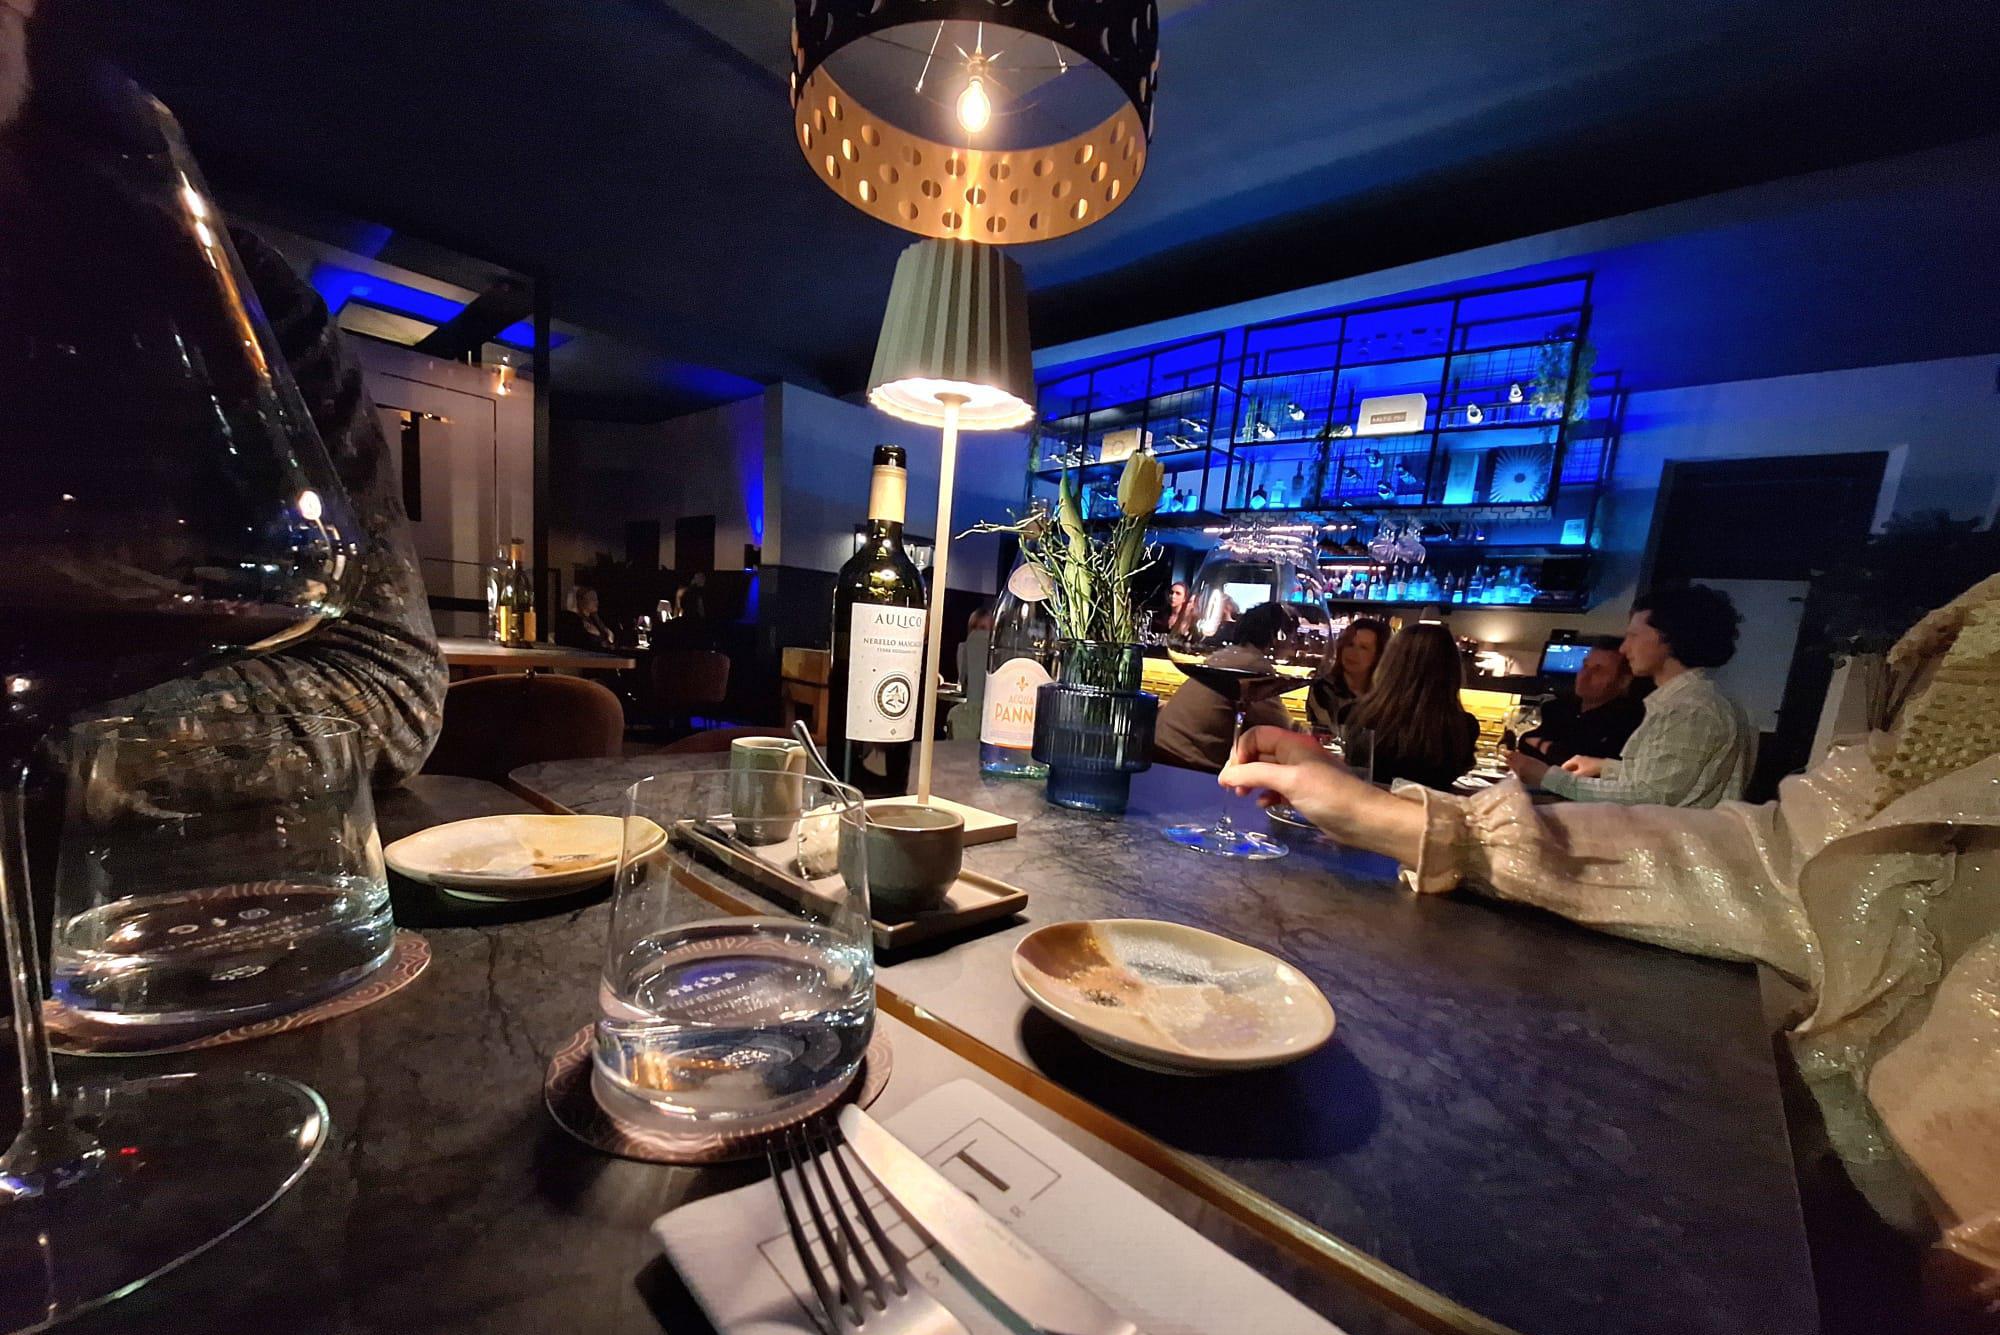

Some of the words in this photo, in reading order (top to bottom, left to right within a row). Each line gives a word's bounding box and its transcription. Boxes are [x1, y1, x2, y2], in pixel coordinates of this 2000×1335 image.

[874, 613, 922, 629] AULICO
[863, 637, 896, 646] NERELLO
[1008, 694, 1034, 705] ACQUA
[995, 702, 1034, 724] PANN
